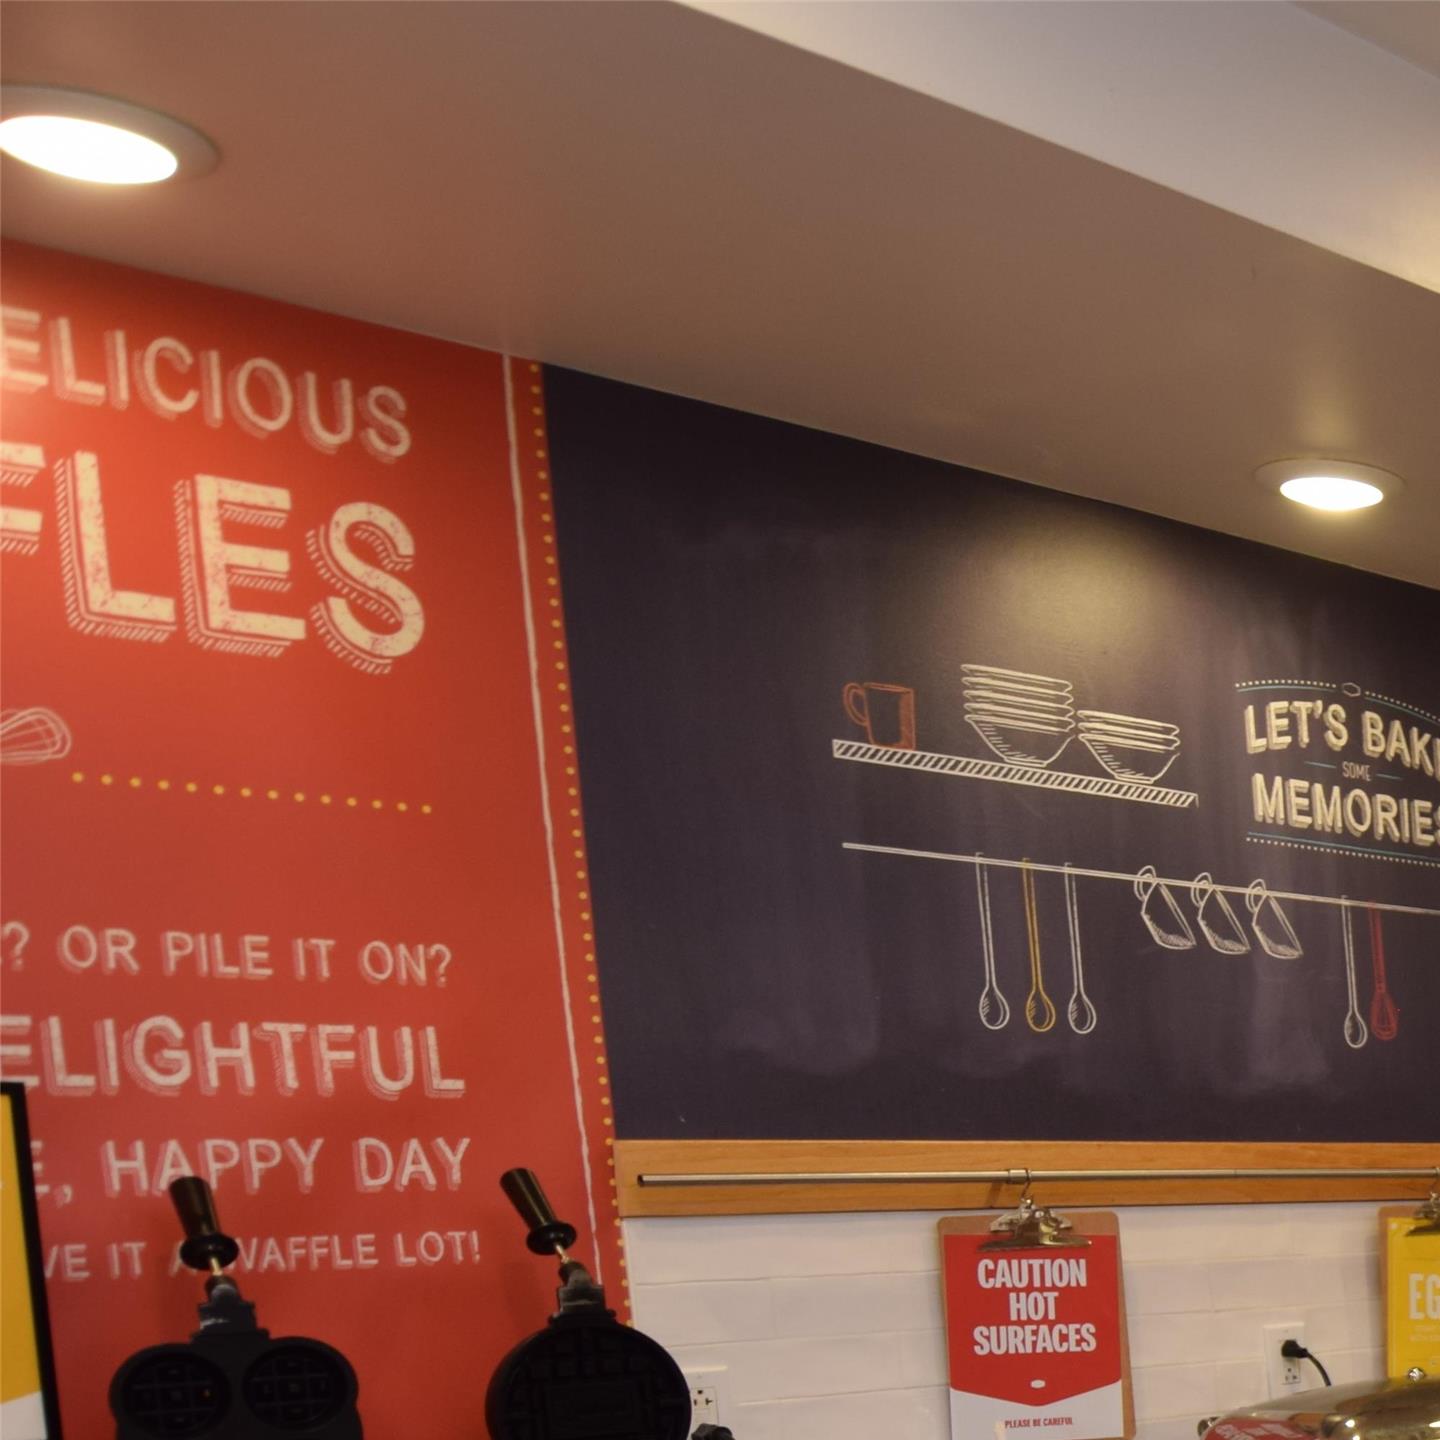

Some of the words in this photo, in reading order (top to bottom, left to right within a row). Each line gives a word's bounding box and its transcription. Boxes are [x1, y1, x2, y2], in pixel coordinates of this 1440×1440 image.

[1244, 699, 1348, 754] LET'S
[1342, 761, 1371, 781] SOME
[57, 925, 139, 975] OR
[162, 931, 273, 979] PILE
[292, 938, 336, 980] IT
[360, 940, 452, 986] ON?
[104, 1137, 324, 1198] HAPPY
[353, 1137, 470, 1193] DAY
[109, 1242, 146, 1279] IT
[394, 1230, 481, 1266] LOT!
[977, 1258, 1087, 1288] CAUTION
[1008, 1292, 1059, 1321] HOT
[973, 1323, 1097, 1355] SURFACES
